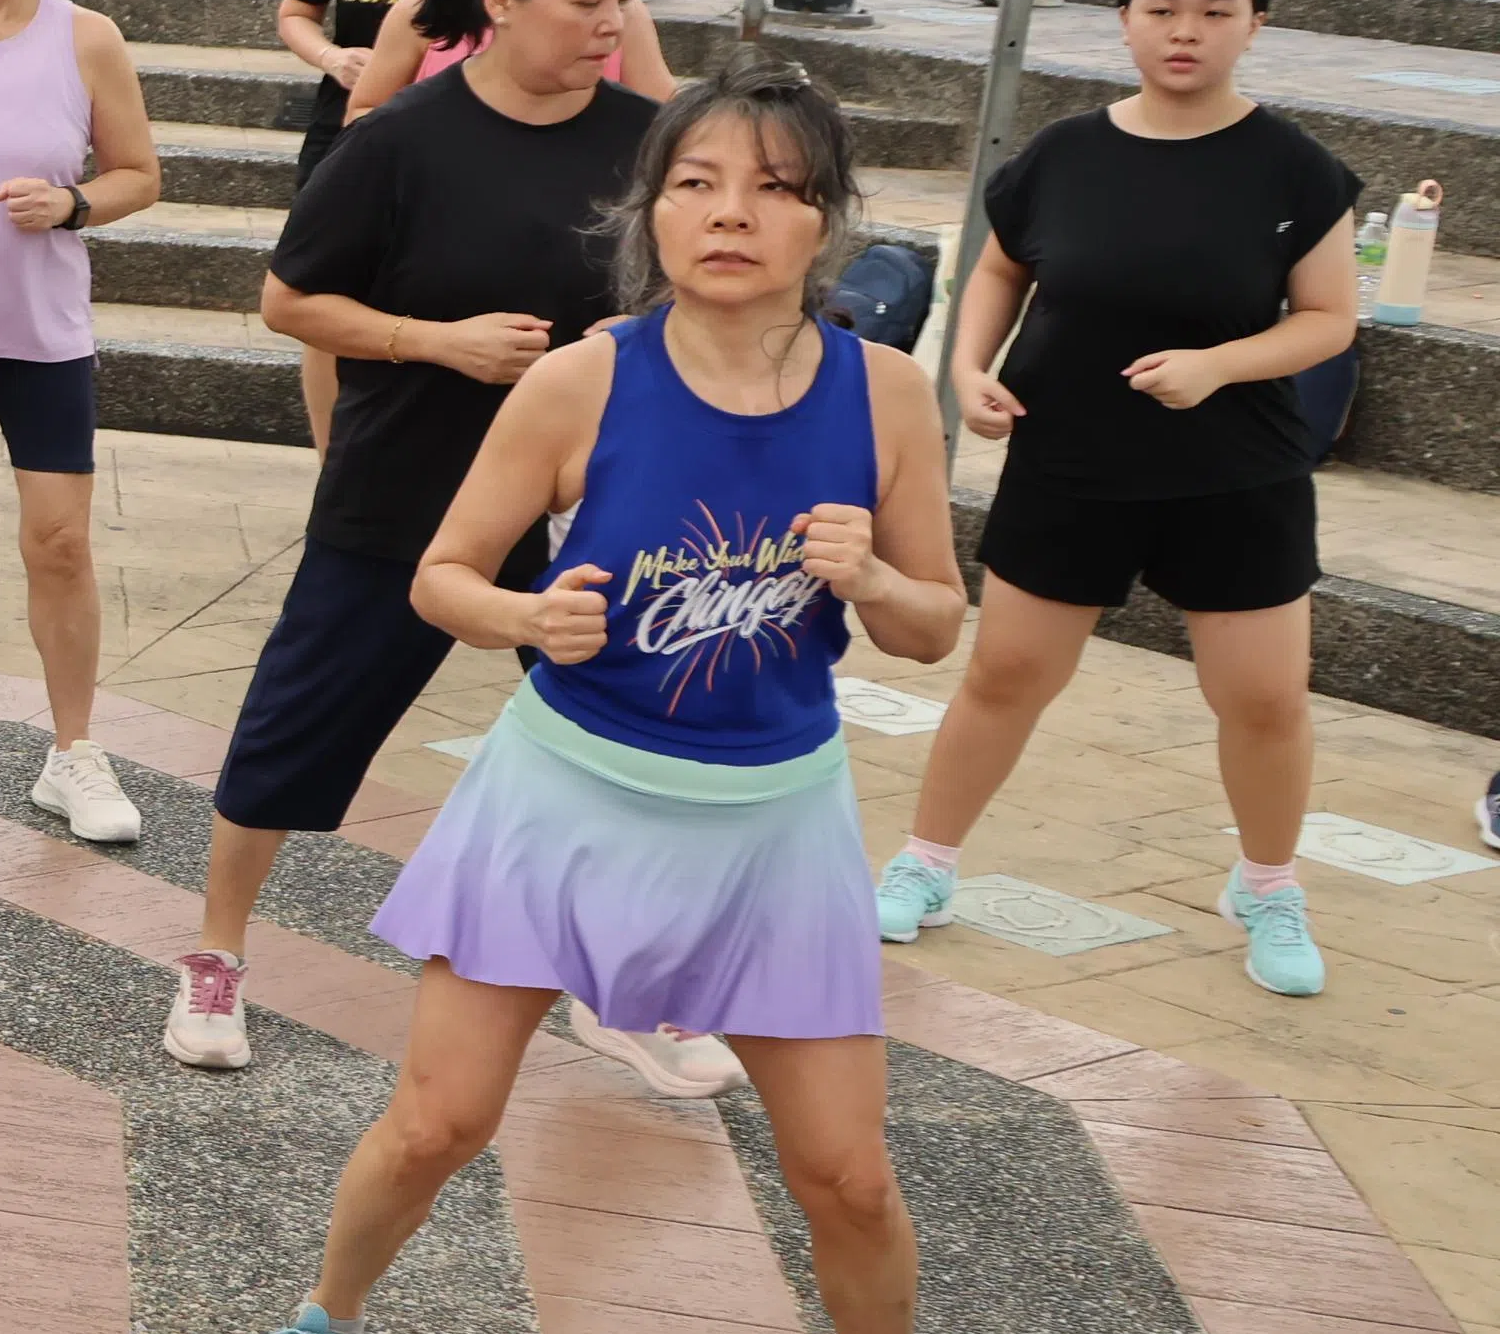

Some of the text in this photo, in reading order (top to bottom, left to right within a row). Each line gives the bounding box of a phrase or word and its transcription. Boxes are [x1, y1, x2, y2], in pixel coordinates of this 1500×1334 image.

[620, 546, 699, 605] Make
[704, 541, 755, 571] Your
[637, 570, 825, 655] Chingay
